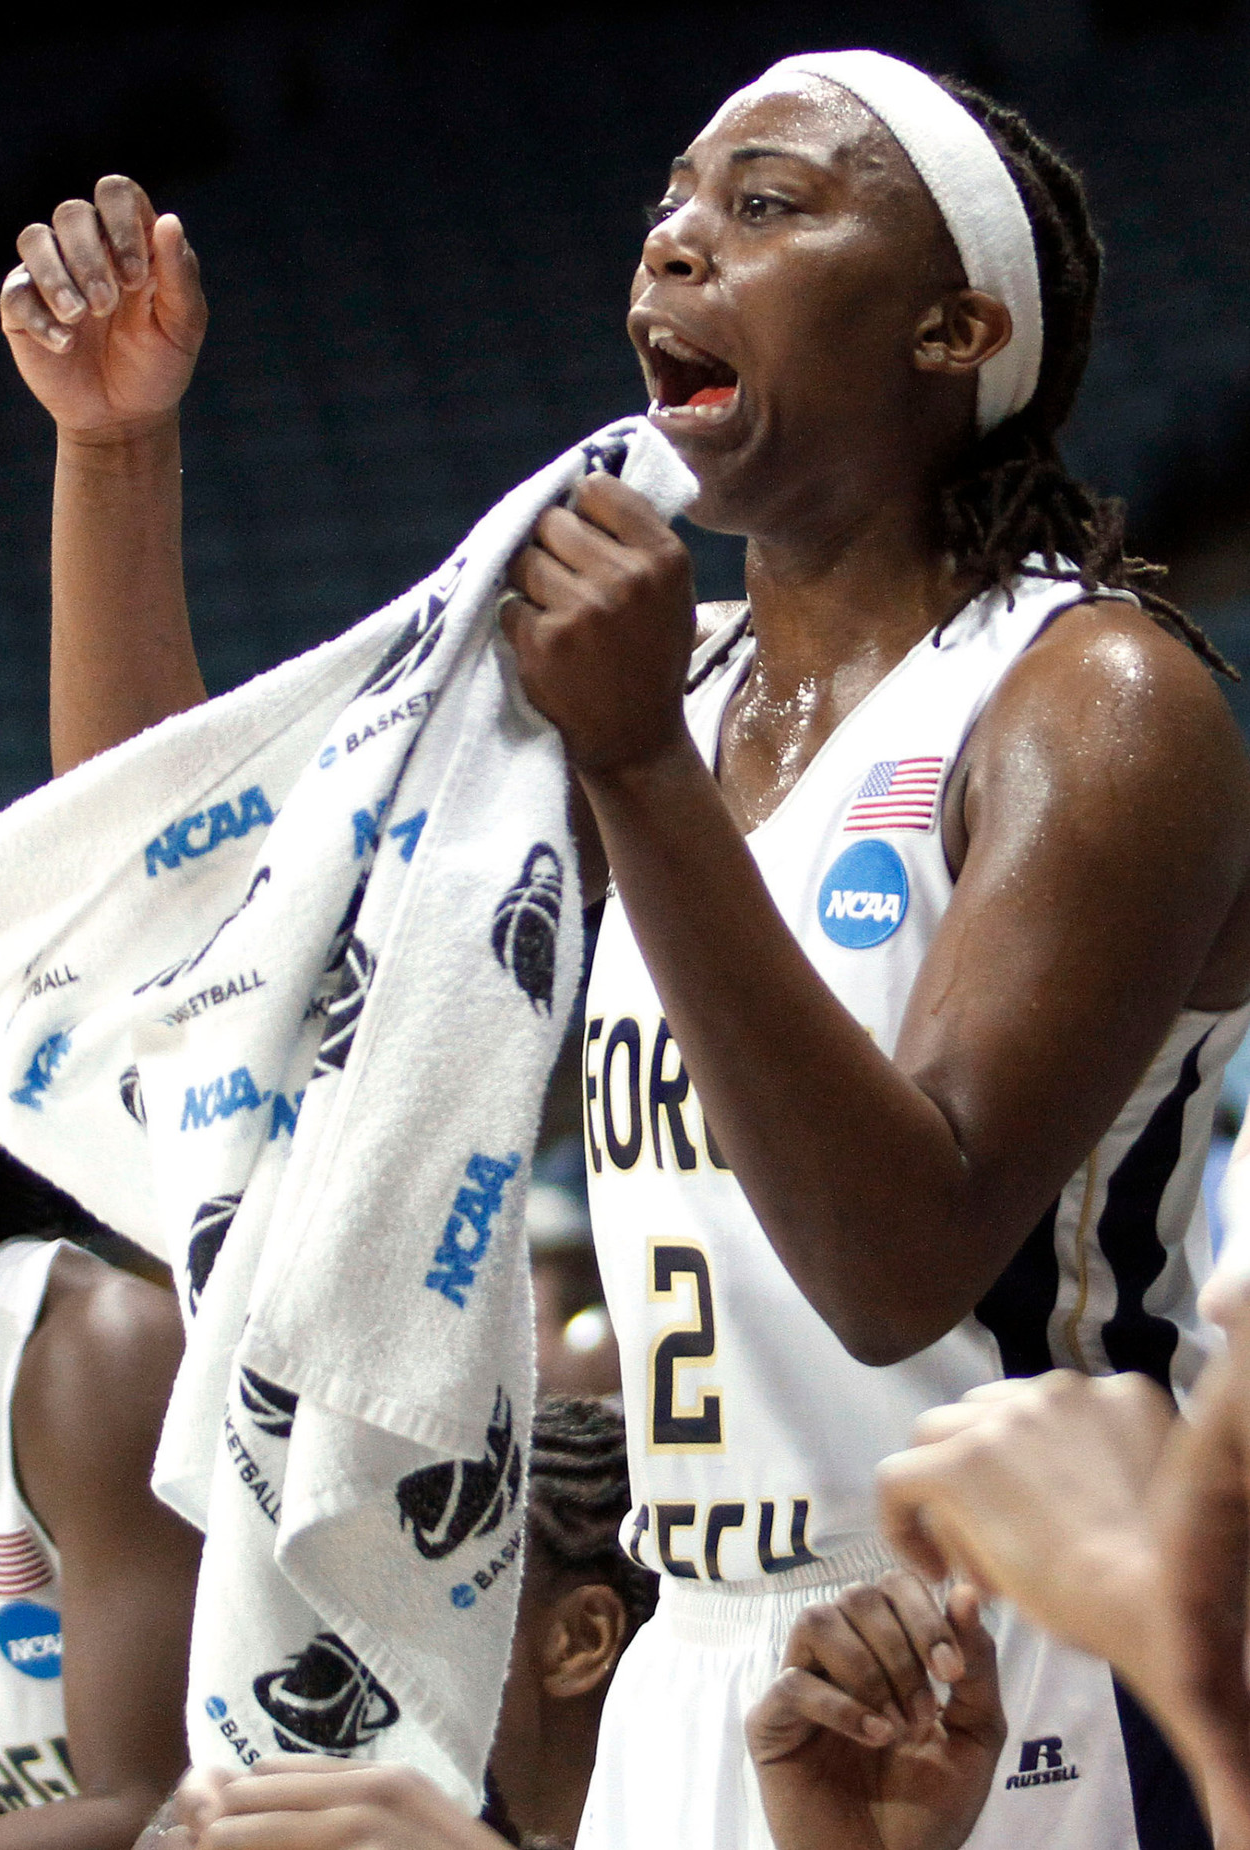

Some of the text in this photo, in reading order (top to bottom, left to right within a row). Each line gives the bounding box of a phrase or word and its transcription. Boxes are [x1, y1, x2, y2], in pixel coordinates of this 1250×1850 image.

[145, 785, 274, 877] NCAA
[825, 889, 900, 923] NCAA
[425, 1153, 517, 1309] NCAA
[648, 1236, 726, 1454] 2
[220, 1719, 260, 1766] BAS
[1006, 1765, 1079, 1790] RUSSELL
